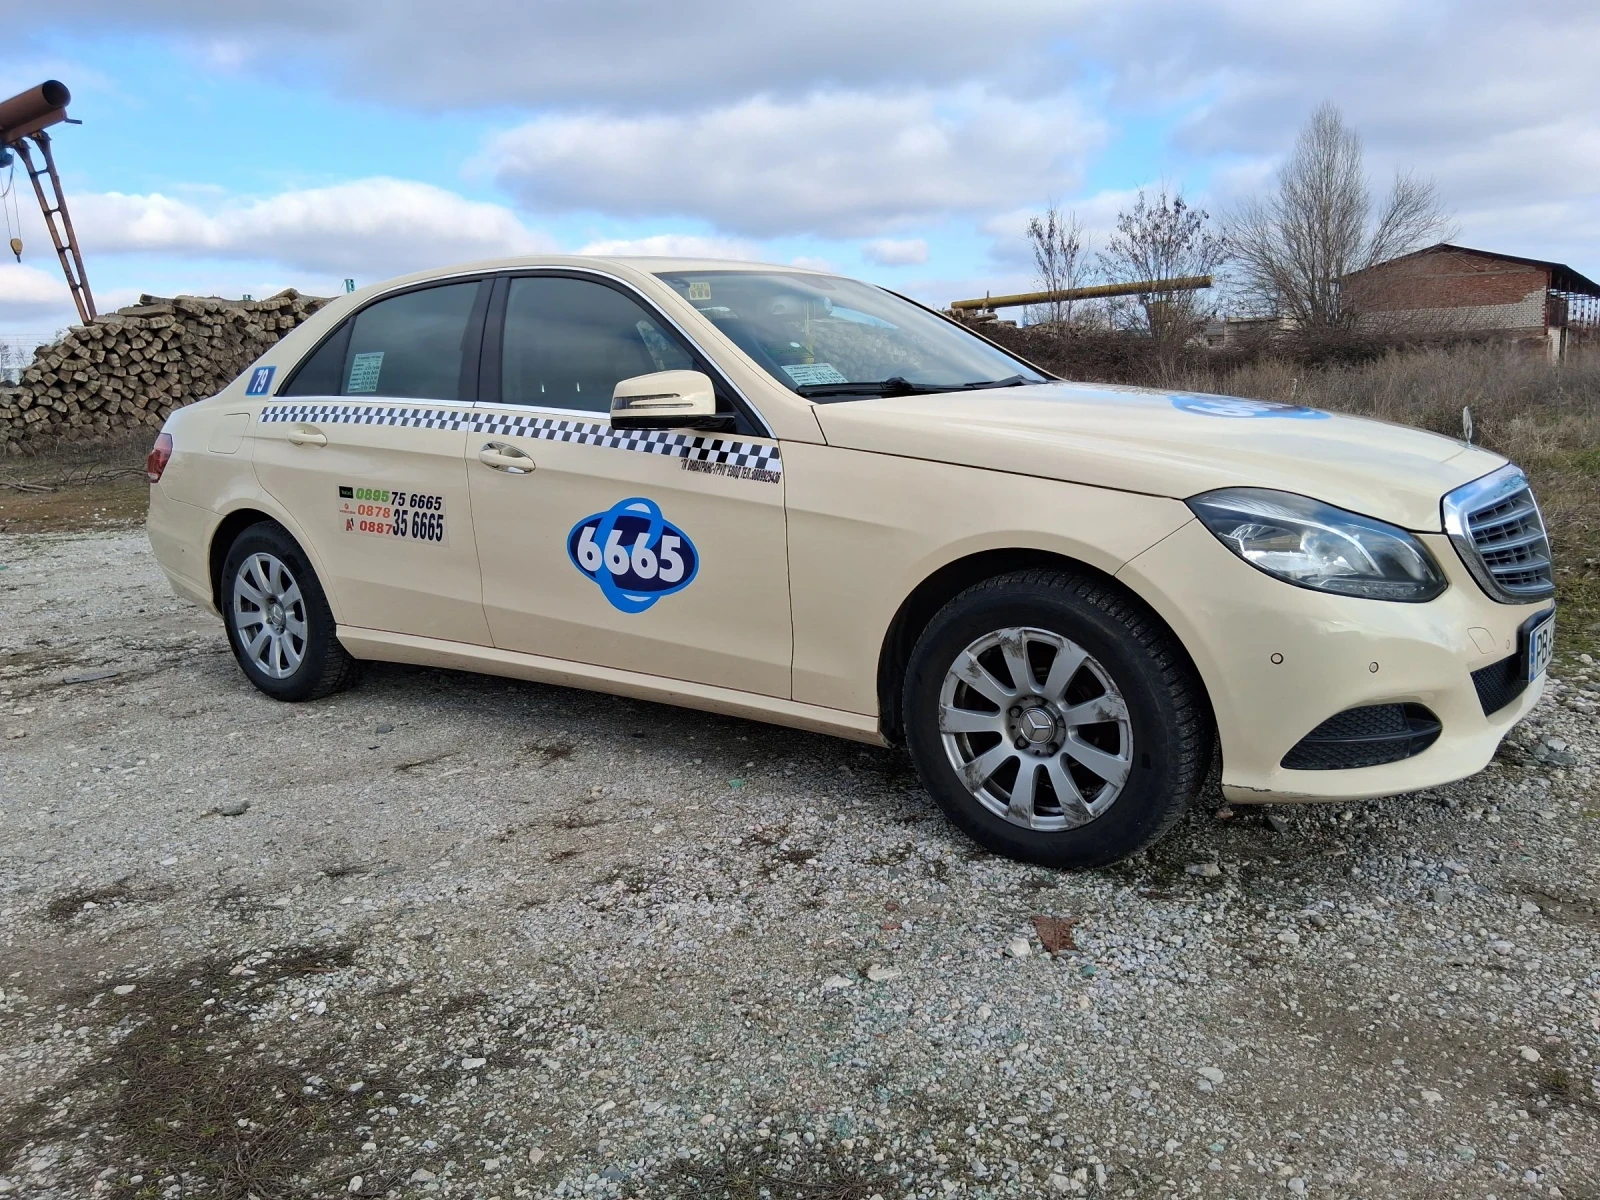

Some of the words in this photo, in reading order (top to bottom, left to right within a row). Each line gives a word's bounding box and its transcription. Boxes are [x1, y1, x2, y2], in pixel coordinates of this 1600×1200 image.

[252, 368, 269, 393] 79
[356, 488, 390, 502] 0895
[391, 491, 406, 507] 75
[409, 494, 442, 511] 6665
[357, 504, 391, 518] 0878
[360, 520, 393, 534] 0887
[393, 508, 408, 536] 35
[411, 511, 444, 542] 6665
[577, 526, 685, 583] 6665
